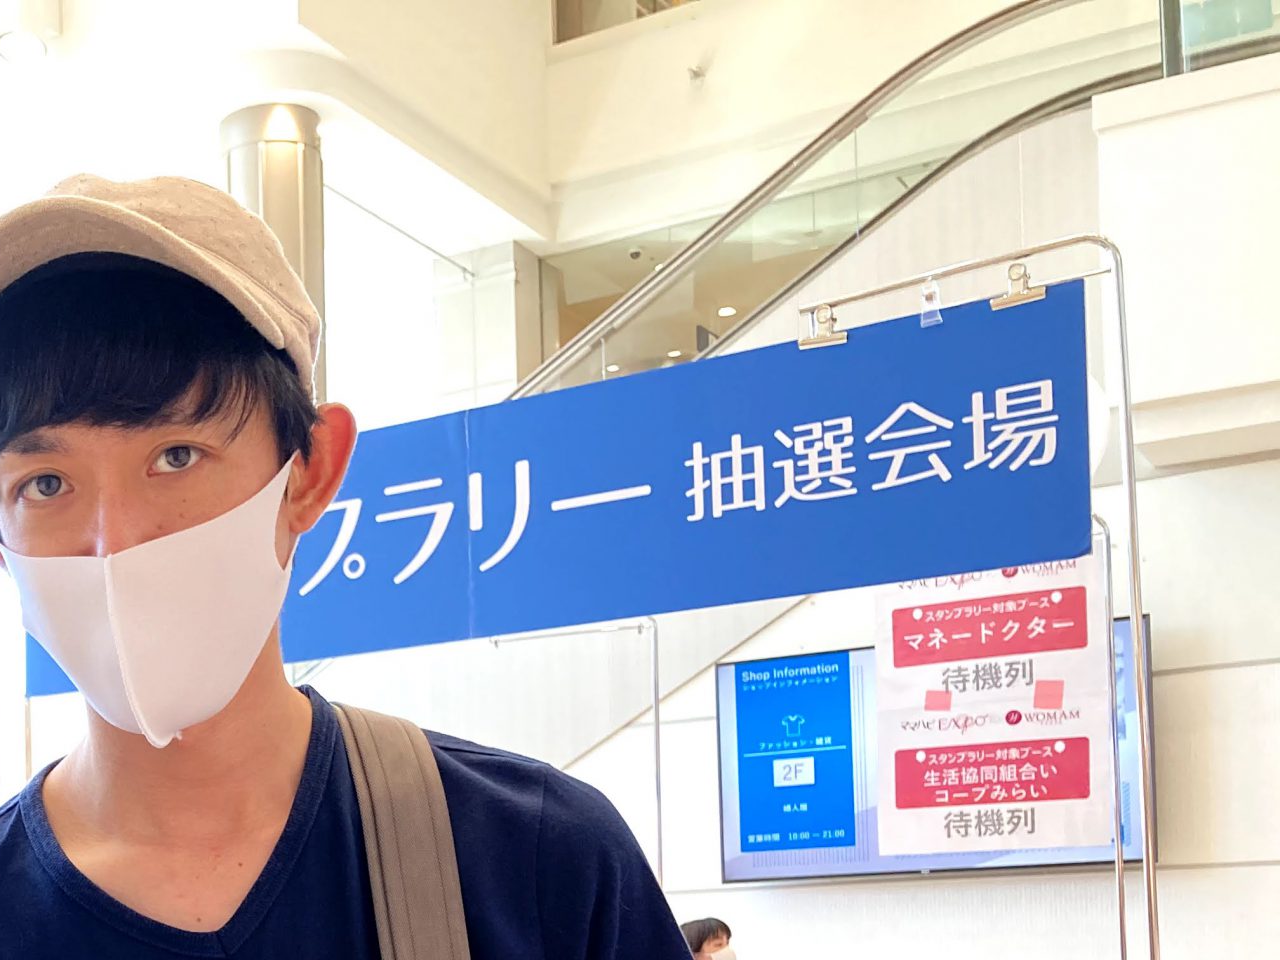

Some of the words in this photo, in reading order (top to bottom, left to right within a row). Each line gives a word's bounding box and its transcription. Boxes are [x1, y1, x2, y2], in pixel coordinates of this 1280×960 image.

[684, 379, 1060, 522] 抽選会場
[925, 597, 1050, 622] スタンプラリー対象ブース
[903, 616, 1075, 651] マネードクター
[741, 671, 770, 682] Shop
[773, 663, 839, 679] Information
[941, 658, 1035, 694] 待機列
[928, 746, 1053, 766] スタンプラリー対象ブース
[782, 763, 805, 782] 2F
[923, 763, 1058, 787] 生活協同組合い
[935, 783, 1048, 803] コープみらい
[943, 807, 1036, 839] 待機列
